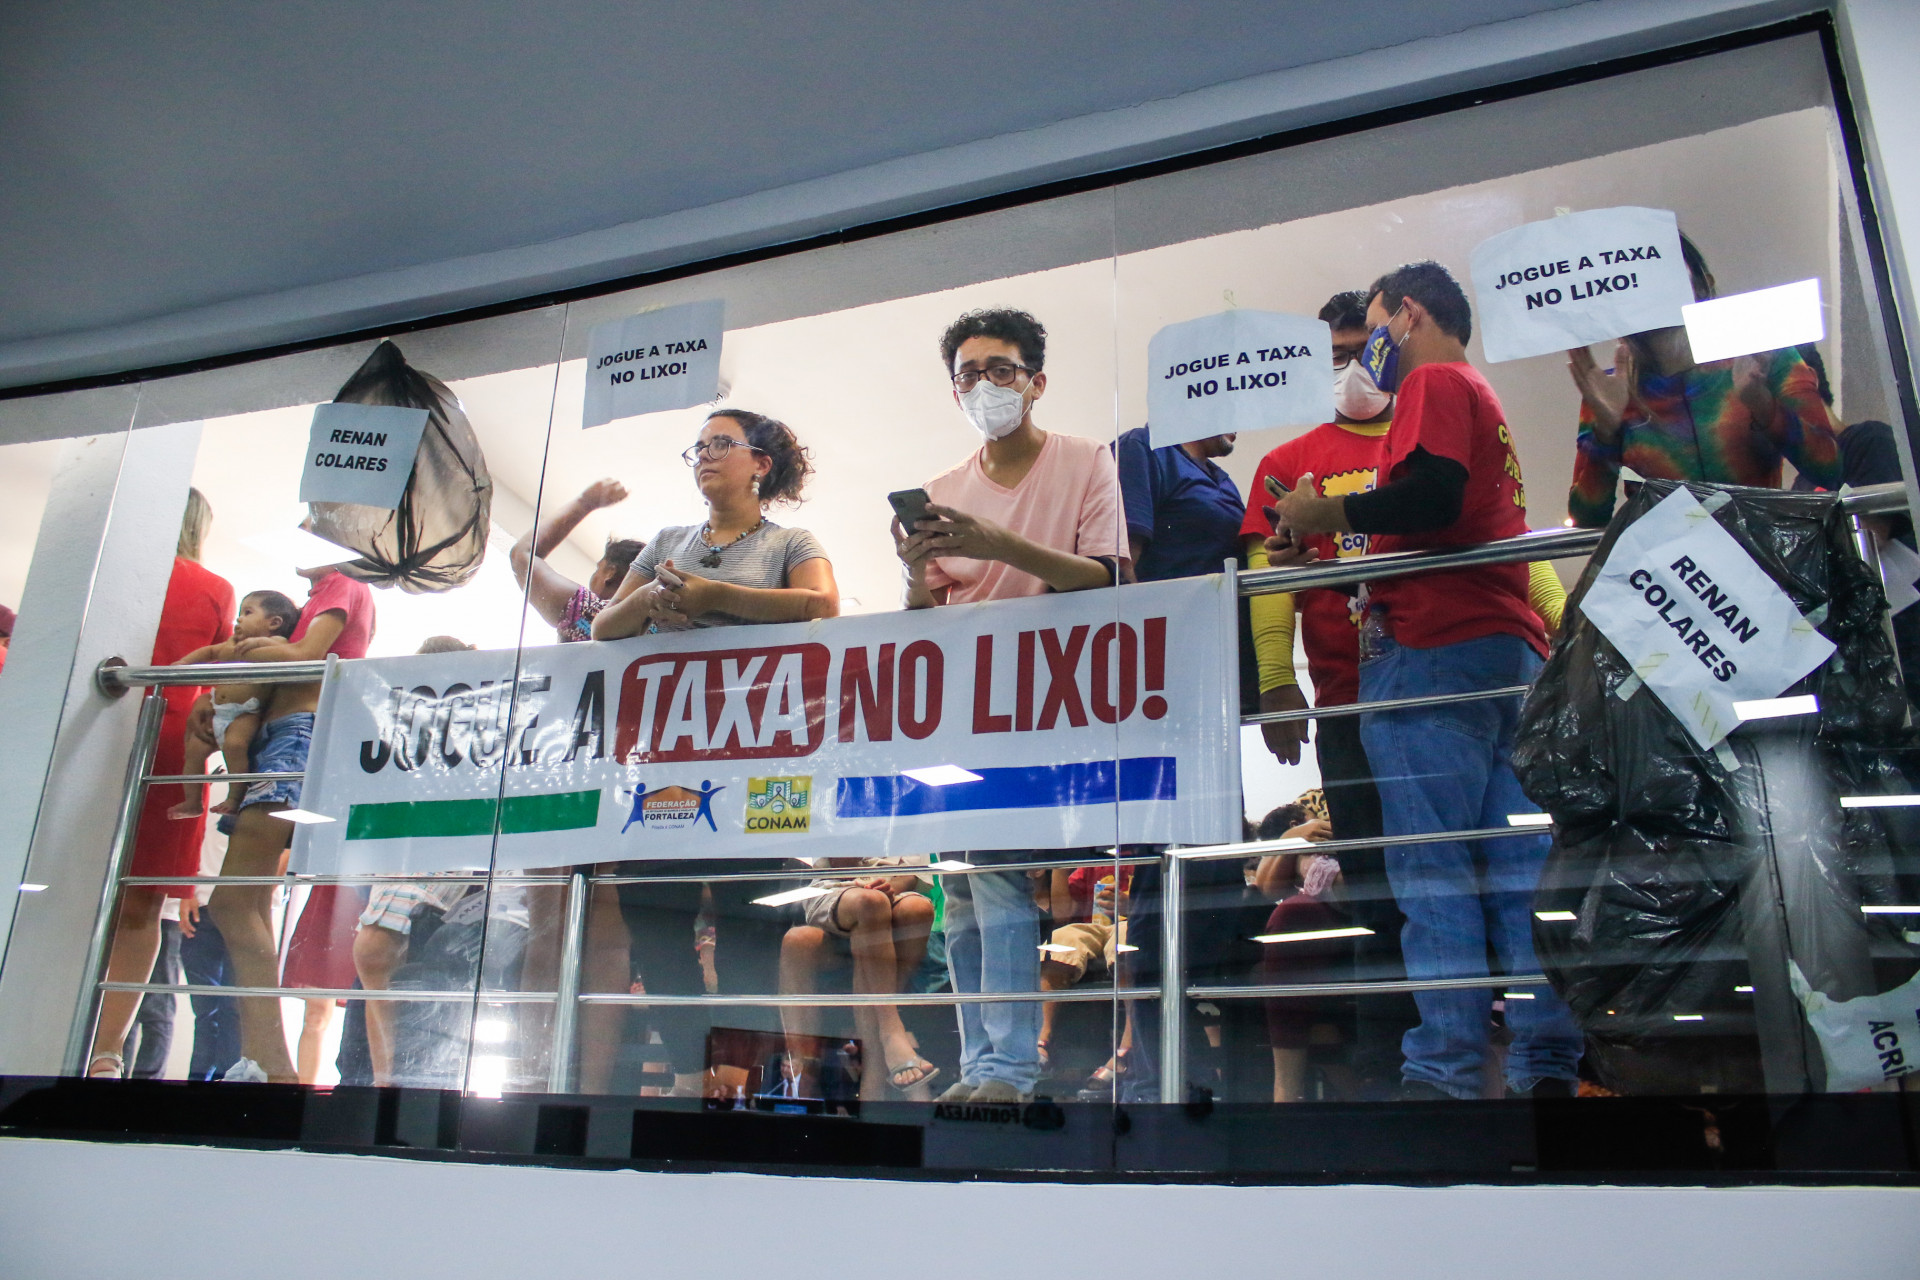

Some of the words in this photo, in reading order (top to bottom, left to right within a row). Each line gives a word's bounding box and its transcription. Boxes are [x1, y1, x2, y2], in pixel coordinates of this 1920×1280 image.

[1495, 260, 1571, 290] JOGUE
[1578, 256, 1594, 270] A
[1599, 245, 1661, 265] TAXA
[1525, 288, 1562, 310] NO
[1570, 272, 1638, 301] LIXO!
[596, 347, 645, 370] JOGUE
[648, 345, 660, 357] A
[665, 338, 708, 355] TAXA
[1164, 353, 1230, 380] JOGUE
[1236, 351, 1251, 365] A
[1256, 345, 1312, 362] TAXA
[610, 370, 635, 386] NO
[640, 361, 687, 381] LIXO!
[1187, 379, 1219, 399] NO
[1226, 370, 1287, 392] LIXO!
[329, 428, 388, 447] RENAN
[315, 452, 388, 472] COLARES
[1670, 554, 1760, 644] RENAN
[1629, 569, 1737, 682] COLARES
[359, 675, 552, 774] JOGUE
[562, 669, 605, 763] A
[636, 651, 810, 752] TAXA
[838, 640, 944, 741] NO
[972, 616, 1168, 735] LIXO!
[645, 812, 695, 821] FORTALEZA
[646, 799, 697, 809] FEDERAÇÃO
[747, 816, 807, 830] CONAM
[1868, 1021, 1914, 1082] ACRÍ
